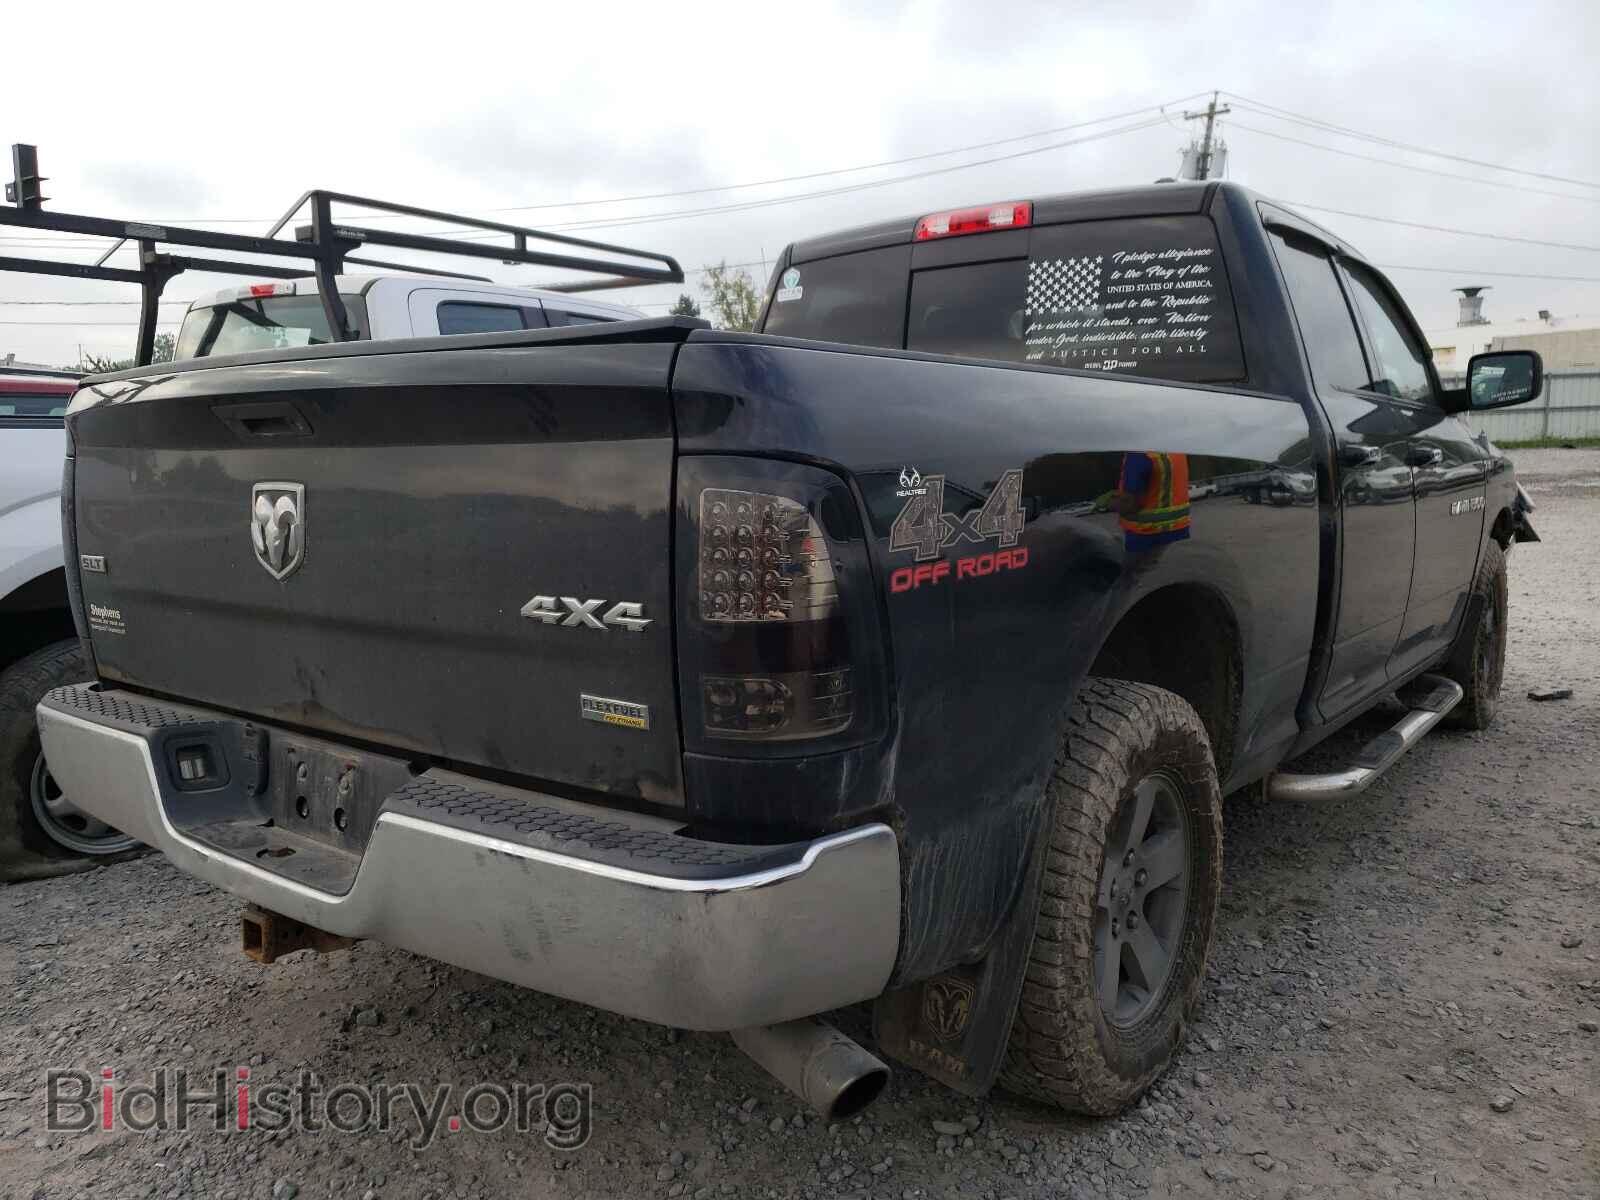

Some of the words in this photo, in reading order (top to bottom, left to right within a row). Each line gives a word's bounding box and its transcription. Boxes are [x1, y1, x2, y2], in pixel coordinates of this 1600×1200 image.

[1120, 251, 1158, 264] pledge
[1158, 248, 1215, 262] allegiance
[1110, 270, 1123, 280] to
[1124, 269, 1144, 279] the
[1177, 264, 1191, 279] of
[1191, 264, 1212, 274] the
[1107, 284, 1135, 294] UNITED
[1136, 283, 1162, 292] STATES
[1163, 281, 1174, 290] OF
[1105, 299, 1127, 310] and
[1127, 299, 1140, 309] to
[1140, 298, 1159, 308] the
[1161, 295, 1212, 309] Republic
[1025, 322, 1045, 335] for
[1045, 319, 1082, 330] which
[1137, 317, 1161, 325] one
[1165, 311, 1213, 324] Nation
[1025, 335, 1056, 345] under
[1140, 329, 1169, 339] with
[1169, 327, 1209, 341] liberty
[1051, 347, 1119, 359] JUSTICE
[1131, 346, 1162, 355] FOR
[1176, 344, 1207, 353] ALL
[896, 488, 927, 498] REALTREE
[82, 557, 102, 570] SLT
[890, 559, 952, 593] OFF
[957, 547, 1030, 580] ROAD
[90, 603, 121, 619] Stephens
